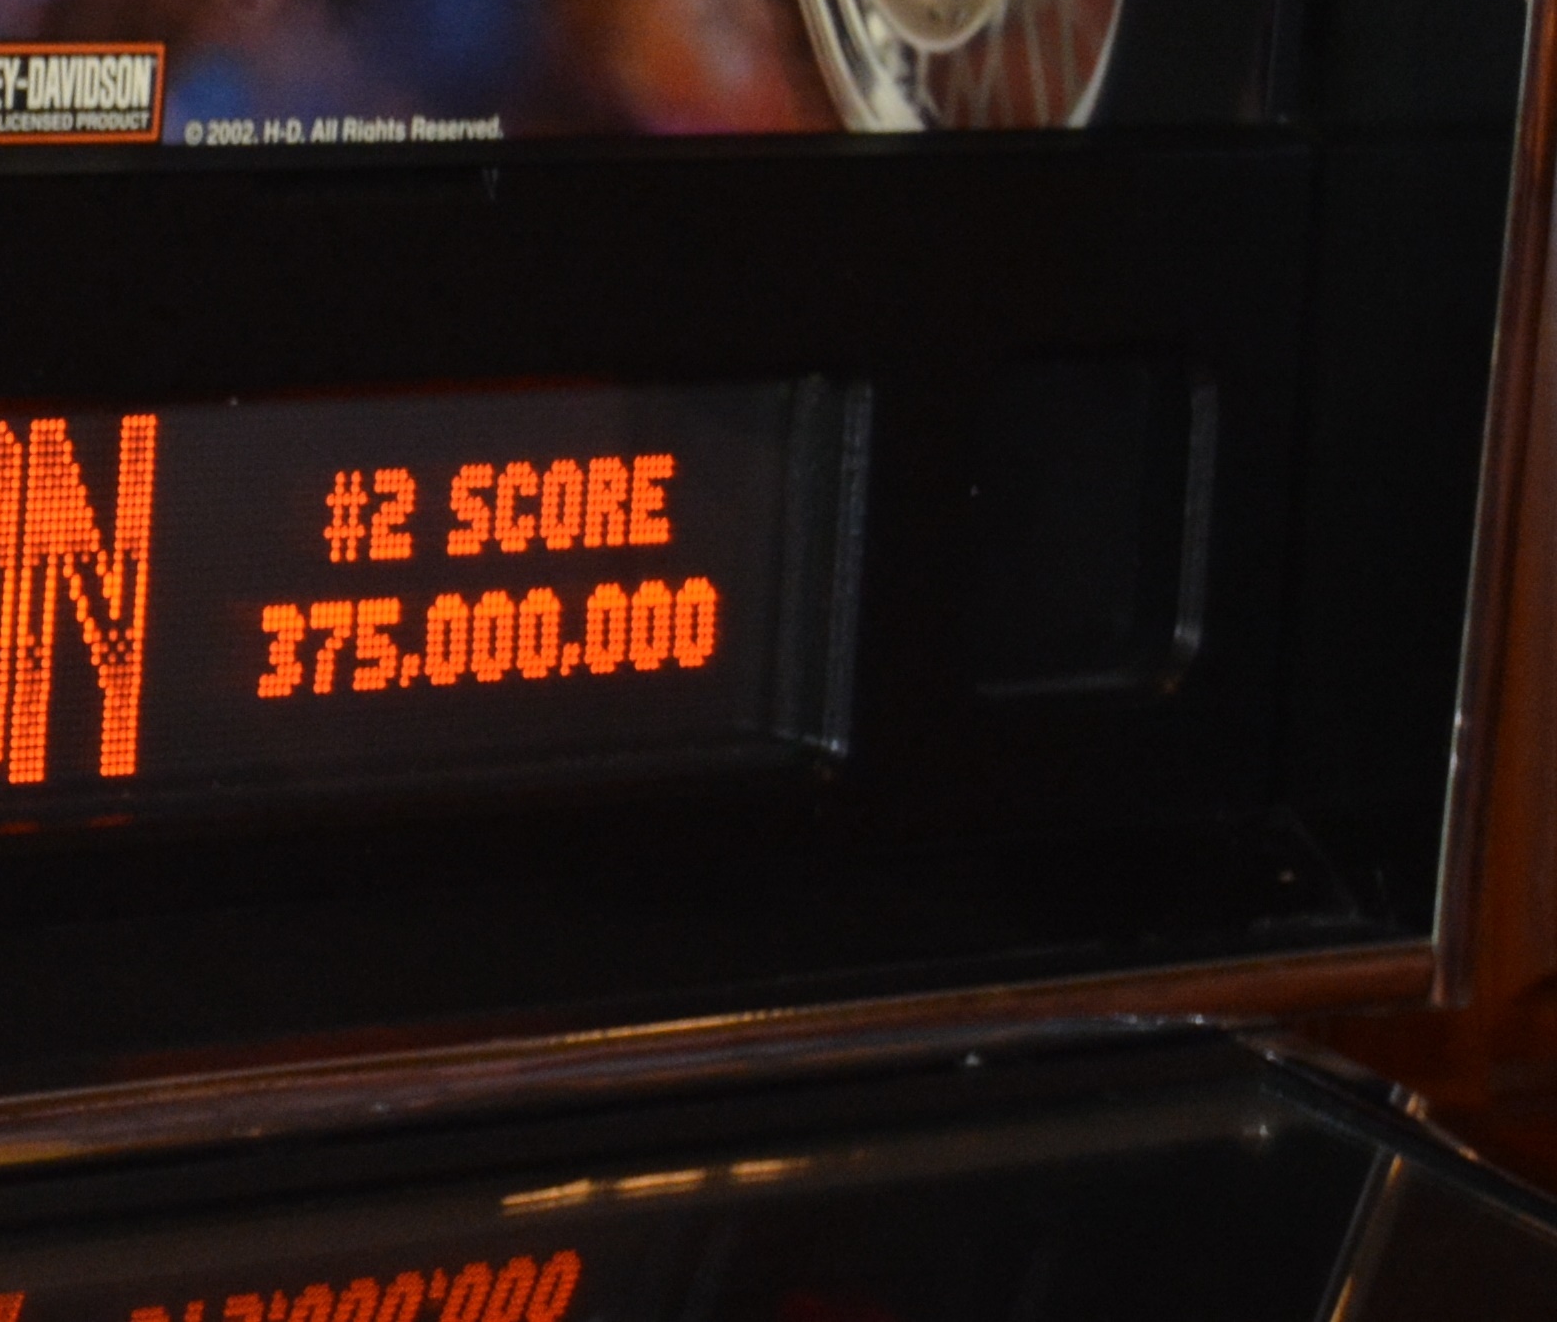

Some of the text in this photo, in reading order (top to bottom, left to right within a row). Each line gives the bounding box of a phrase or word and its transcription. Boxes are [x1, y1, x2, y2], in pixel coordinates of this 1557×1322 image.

[76, 110, 150, 131] PRODUCT
[311, 116, 338, 143] All
[343, 115, 406, 143] Rights
[323, 453, 675, 563] #2 SCORE
